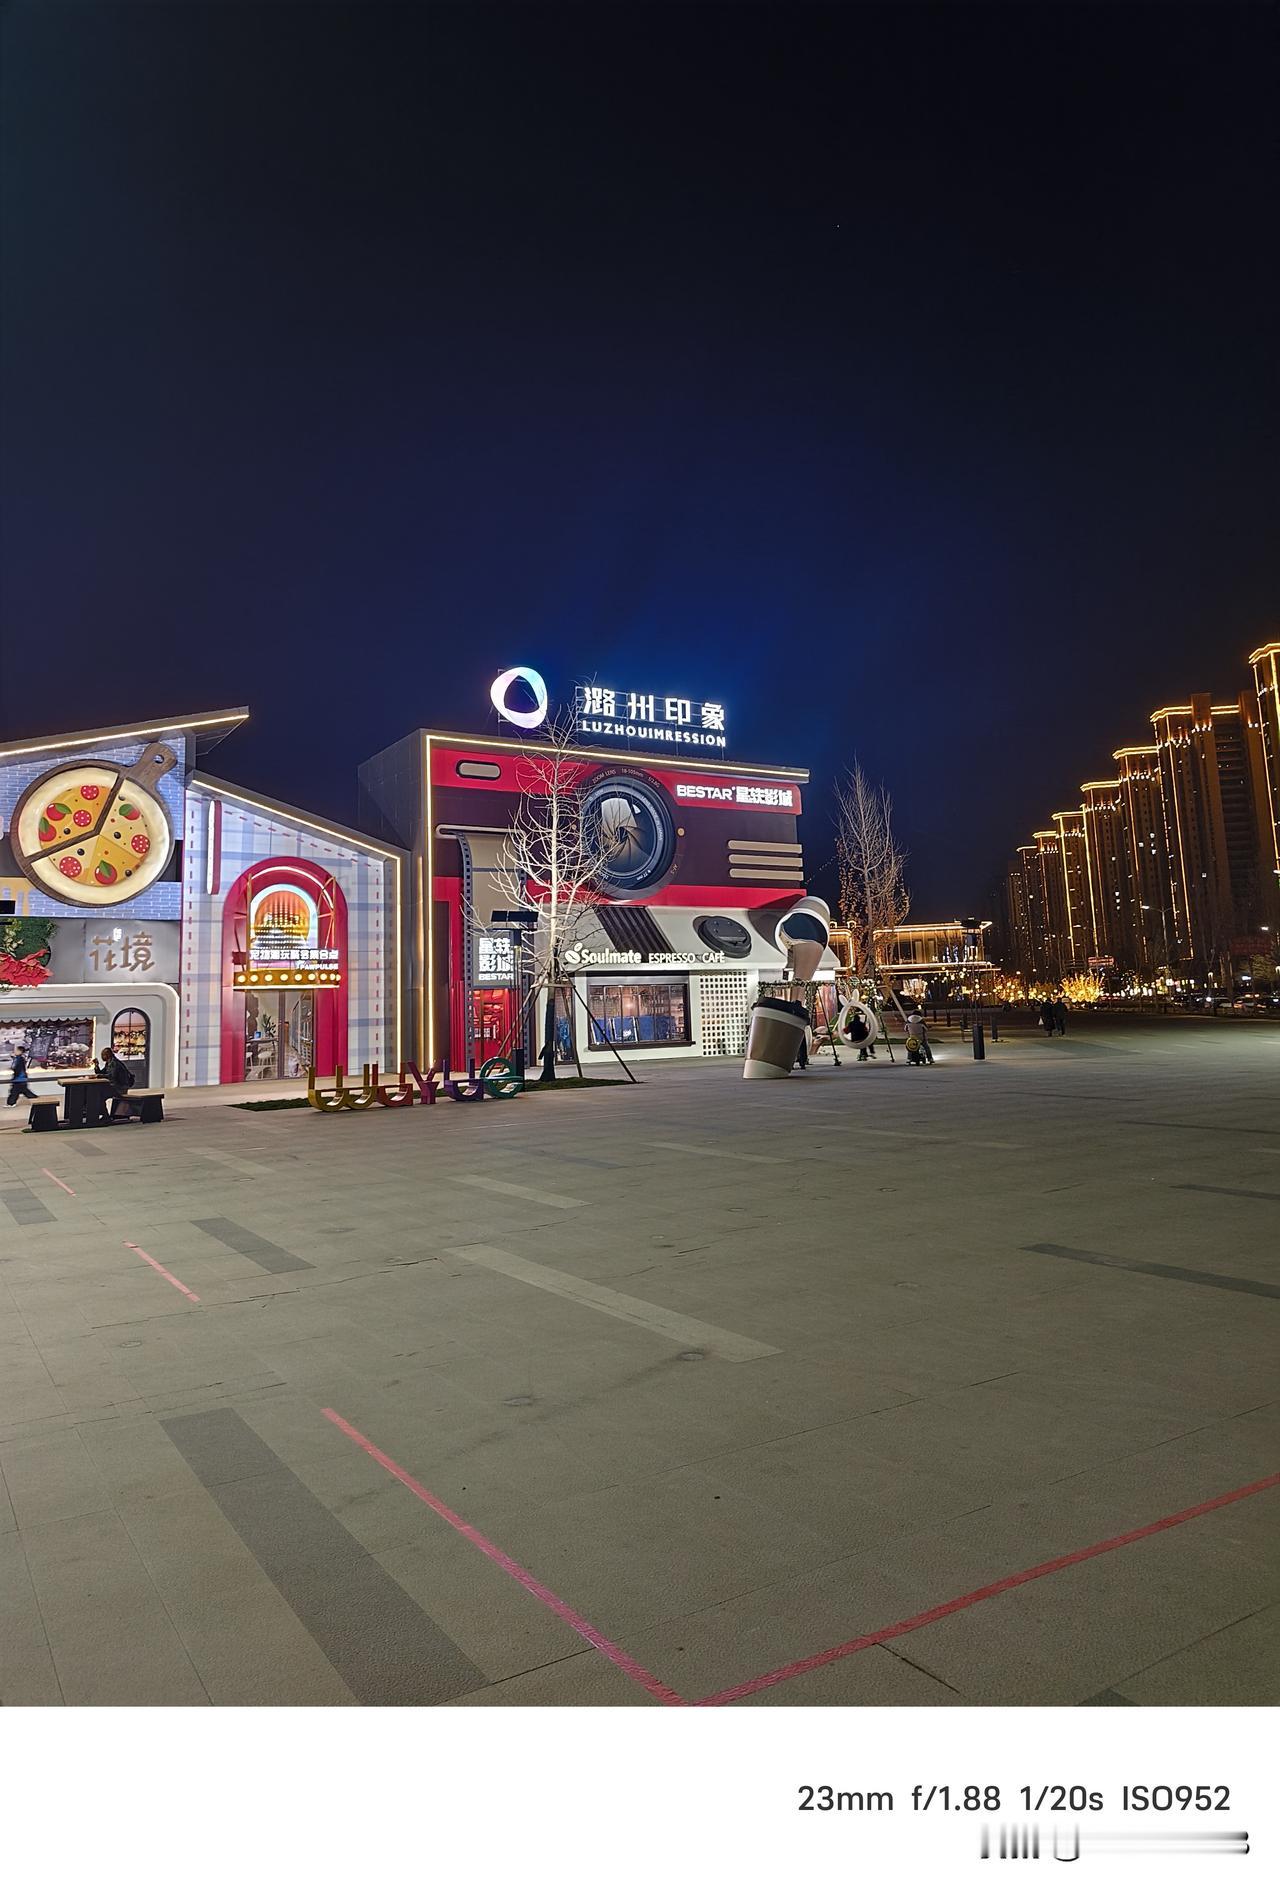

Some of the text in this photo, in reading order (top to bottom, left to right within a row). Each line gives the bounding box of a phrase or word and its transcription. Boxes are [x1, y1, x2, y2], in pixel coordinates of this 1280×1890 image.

[583, 686, 725, 731] 潞州印象
[581, 719, 726, 747] LUZHOUIMRESSION
[676, 784, 733, 801] BESTAR
[89, 930, 155, 973] 花境
[581, 948, 642, 964] Soulmate
[648, 952, 696, 964] ESPRESSO
